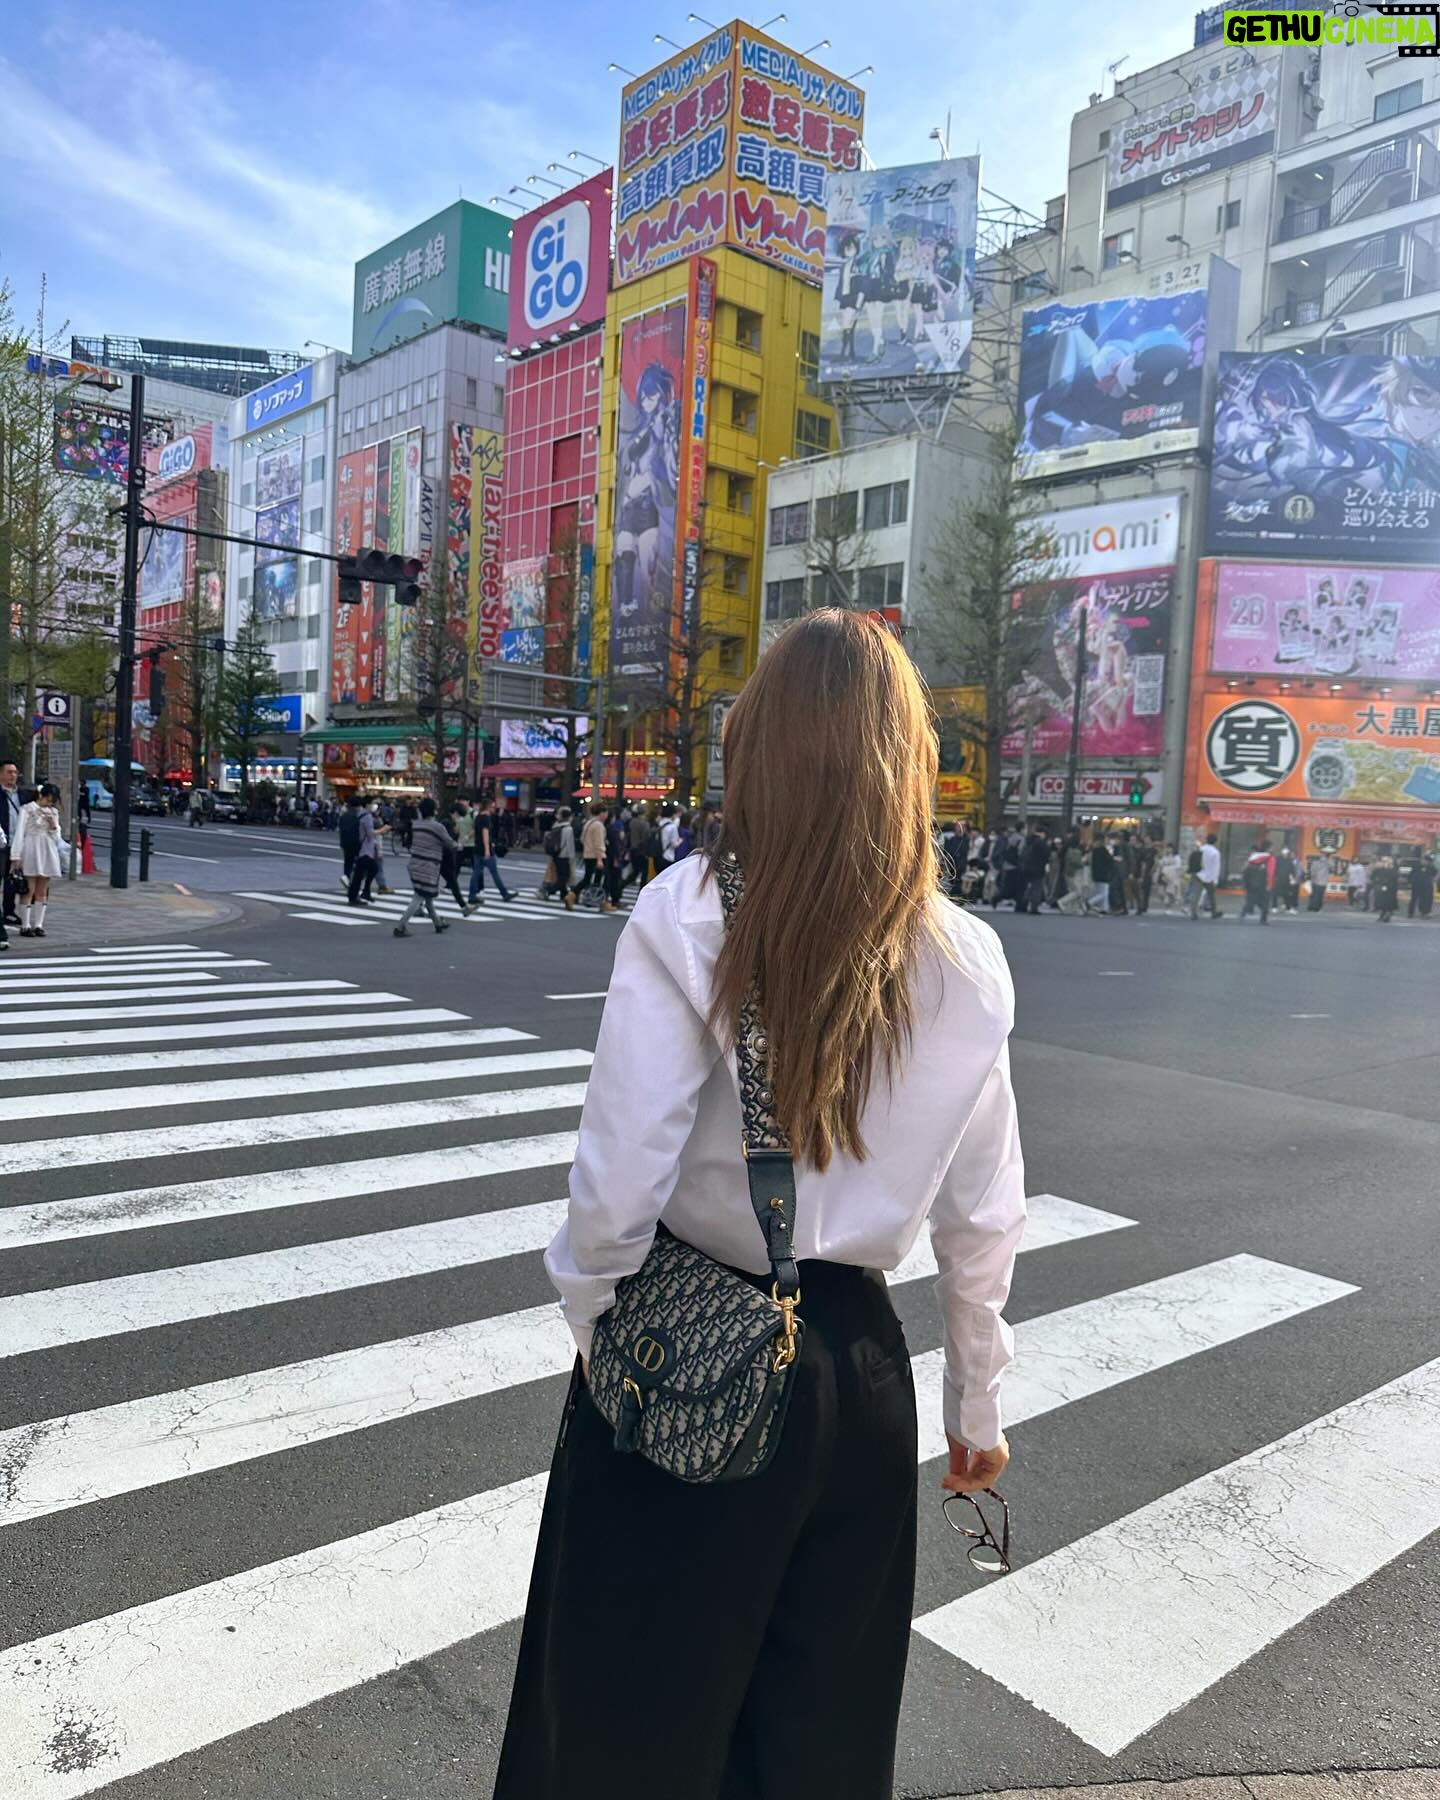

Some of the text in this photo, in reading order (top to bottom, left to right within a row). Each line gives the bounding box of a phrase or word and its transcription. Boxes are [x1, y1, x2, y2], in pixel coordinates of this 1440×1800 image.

[623, 71, 730, 171] 激安販売
[740, 76, 859, 170] 激安販売
[619, 125, 726, 223] 高額買取
[735, 134, 828, 210] 高額買
[733, 190, 826, 257] Mula
[1342, 488, 1440, 511] どんな宇宙
[1342, 507, 1430, 530] 巡り会える
[1099, 779, 1123, 794] ZIN
